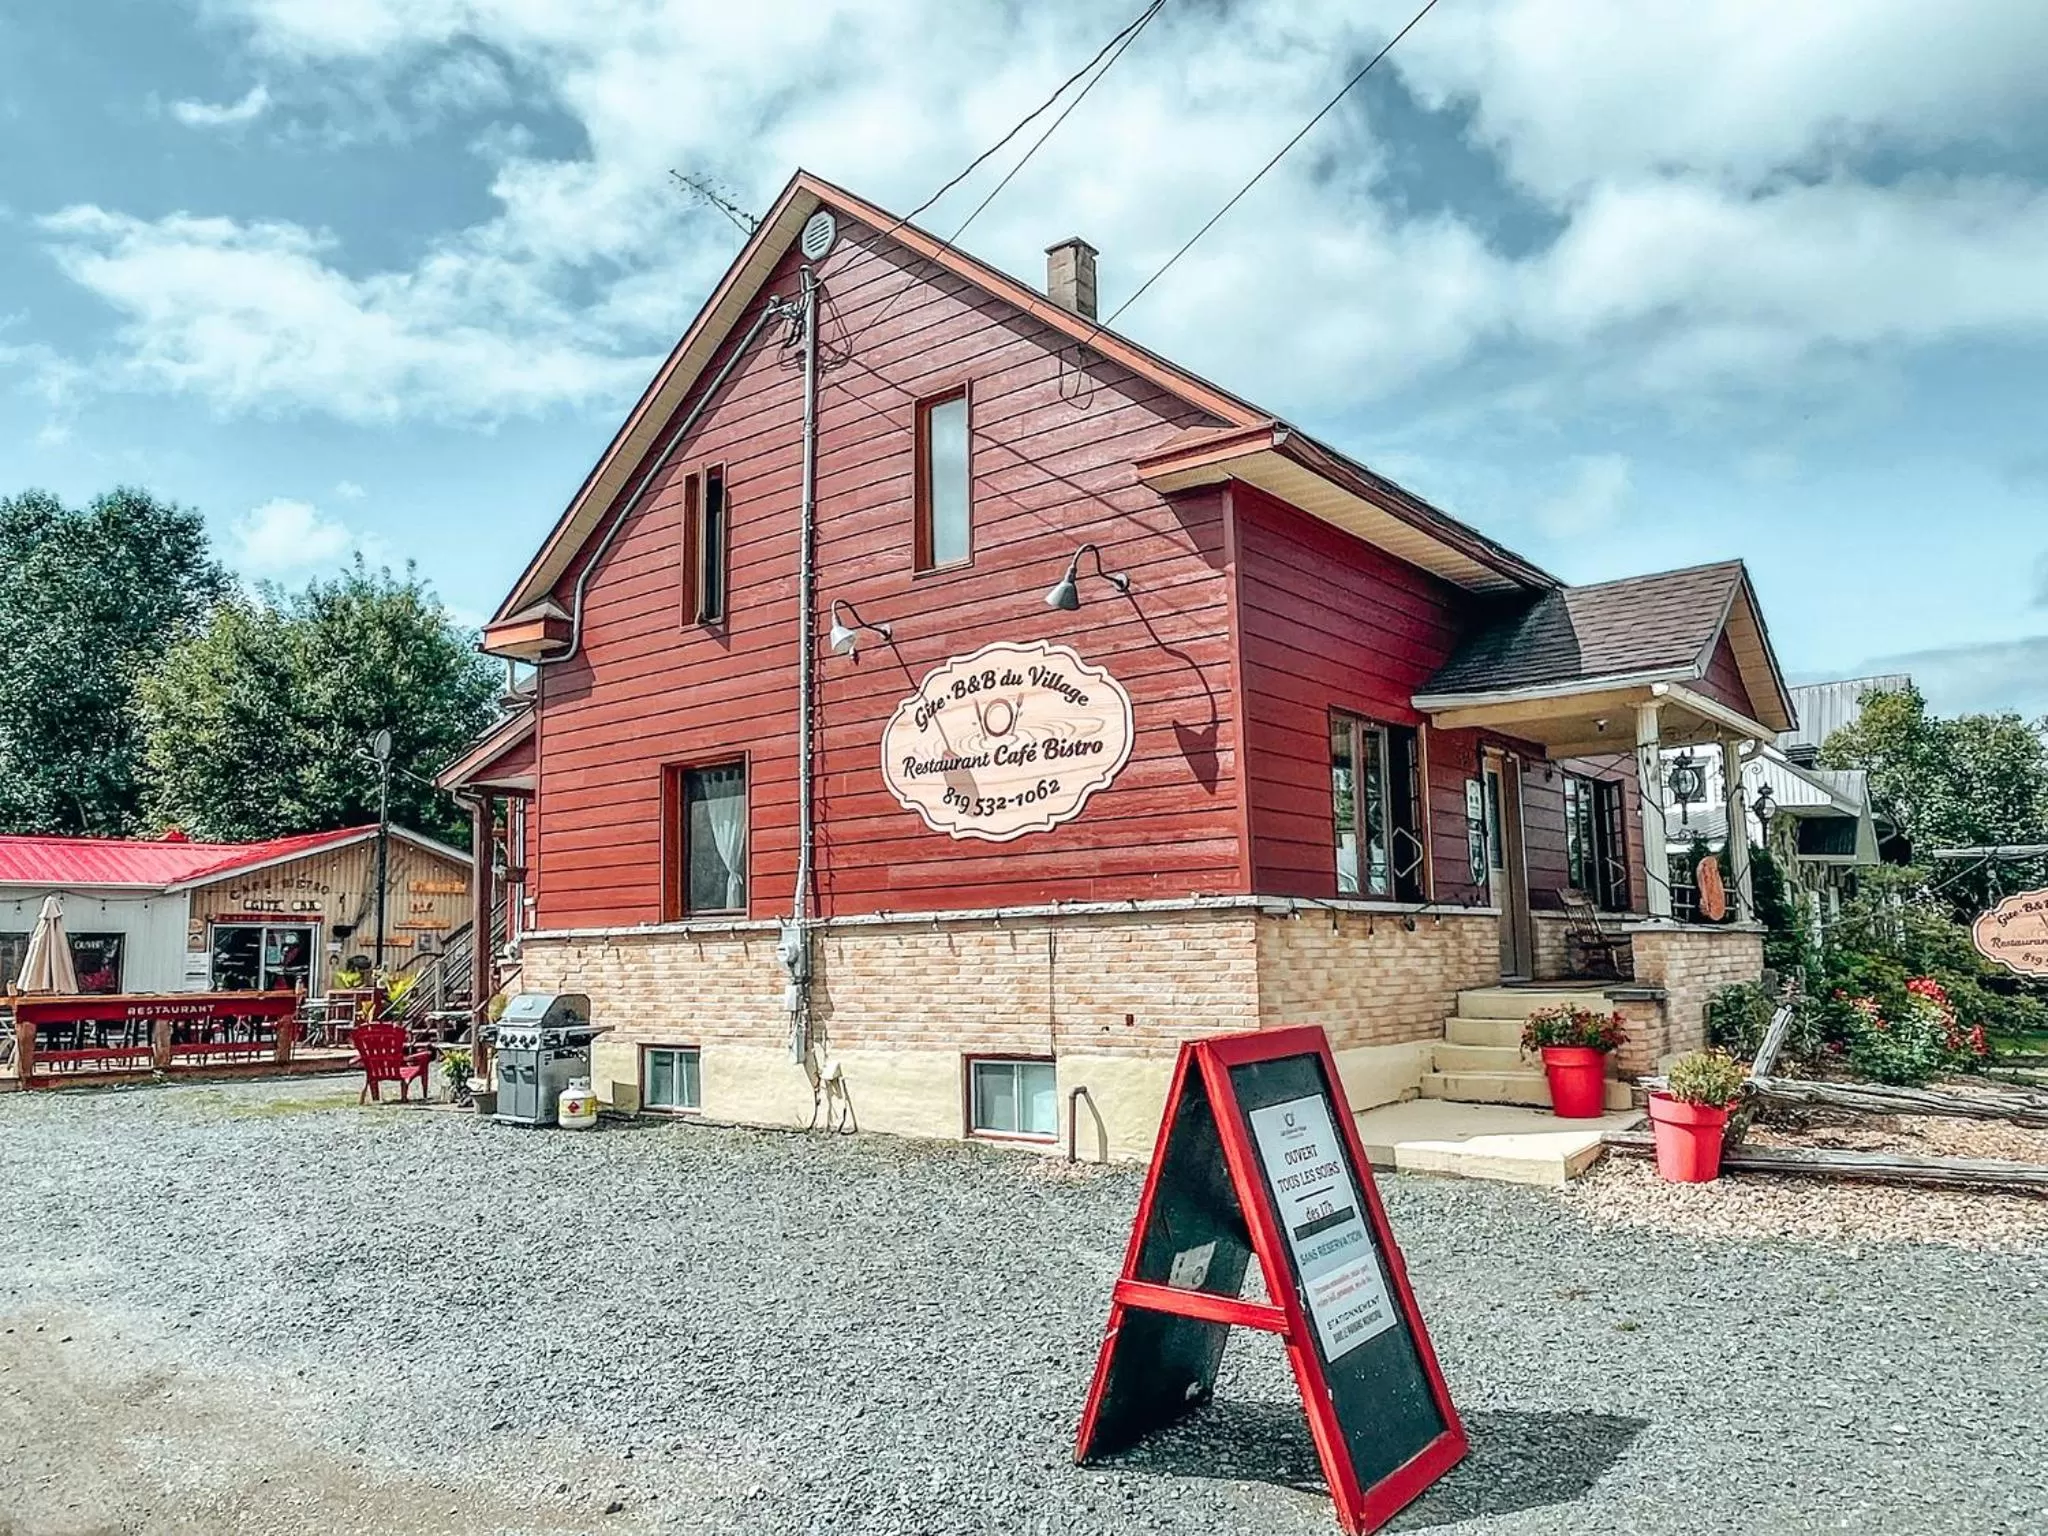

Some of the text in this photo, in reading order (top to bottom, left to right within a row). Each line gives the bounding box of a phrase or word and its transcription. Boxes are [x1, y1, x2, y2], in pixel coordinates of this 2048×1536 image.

[950, 669, 997, 700] B&B
[1000, 668, 1023, 687] du
[1028, 665, 1090, 707] Village
[902, 737, 1104, 780] Restaurant Café Bistro
[942, 779, 1061, 816] 819 532-1062
[127, 1003, 216, 1016] RESTAURANT
[1284, 1144, 1318, 1166] OUVERT
[1277, 1161, 1341, 1193] TOUS LES SOIRS
[1299, 1248, 1319, 1266] SANS
